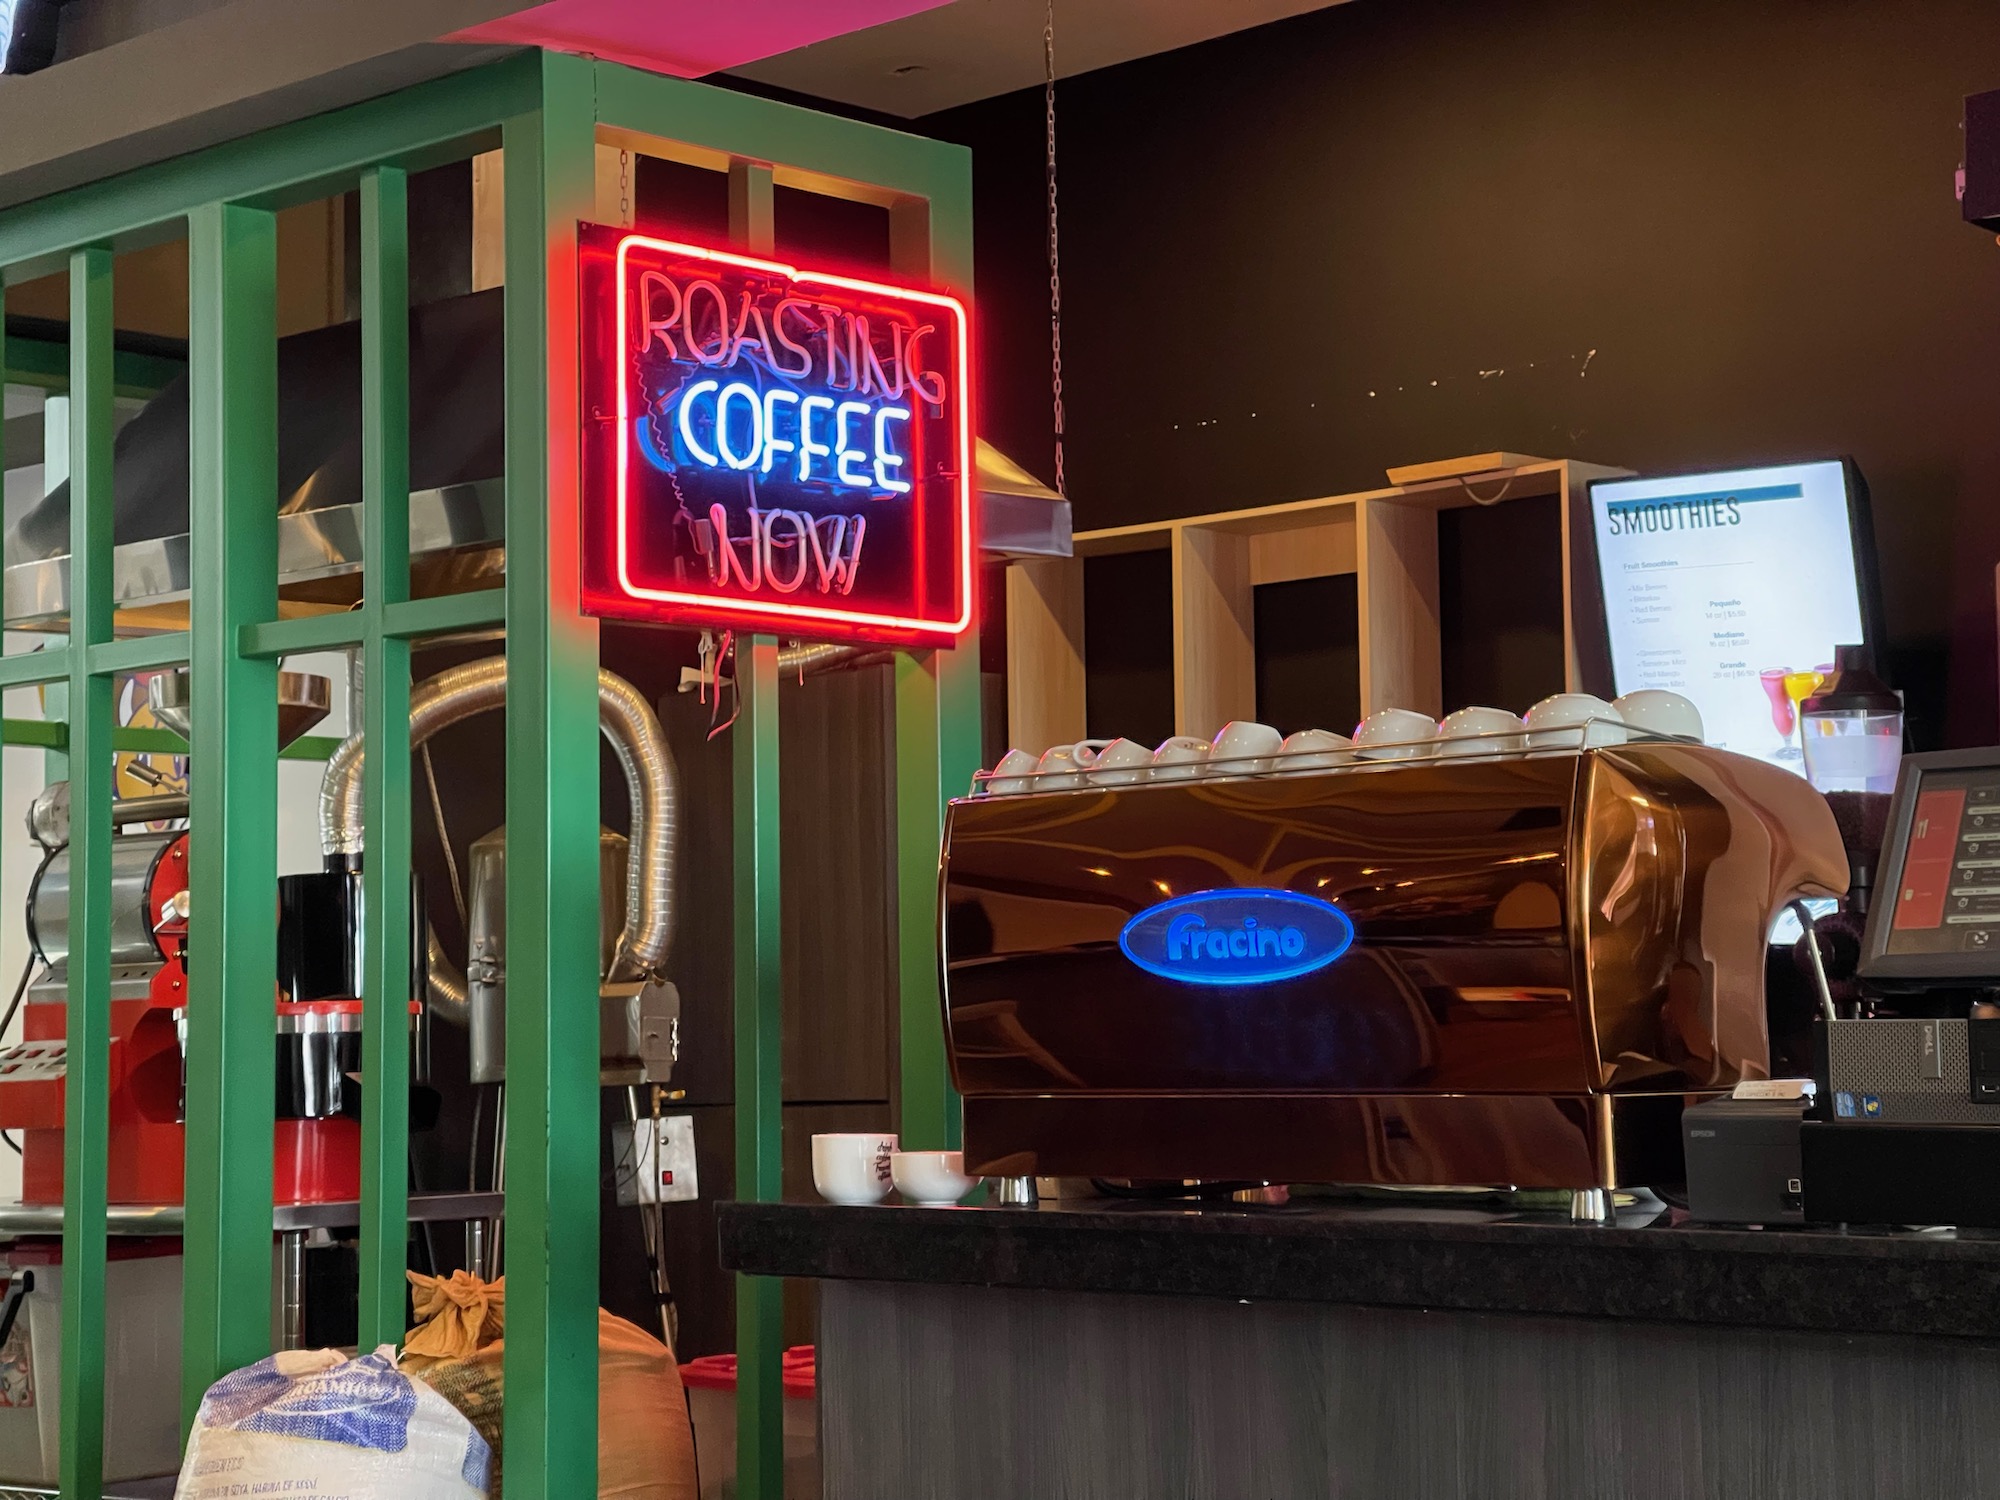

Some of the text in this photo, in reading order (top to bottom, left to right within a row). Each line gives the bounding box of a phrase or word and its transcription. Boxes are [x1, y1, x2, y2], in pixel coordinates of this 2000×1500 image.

[640, 270, 946, 404] ROASTING
[678, 380, 911, 494] COFFEE
[1608, 496, 1741, 536] SMOOTHIES
[709, 502, 867, 596] NOW
[1623, 559, 1678, 570] Fruit Smoothies
[1709, 599, 1742, 608] Pequeño
[1713, 631, 1745, 639] Mediano
[1720, 661, 1747, 669] Grande
[1923, 1025, 1935, 1056] DELL
[1690, 1129, 1716, 1138] EPSON
